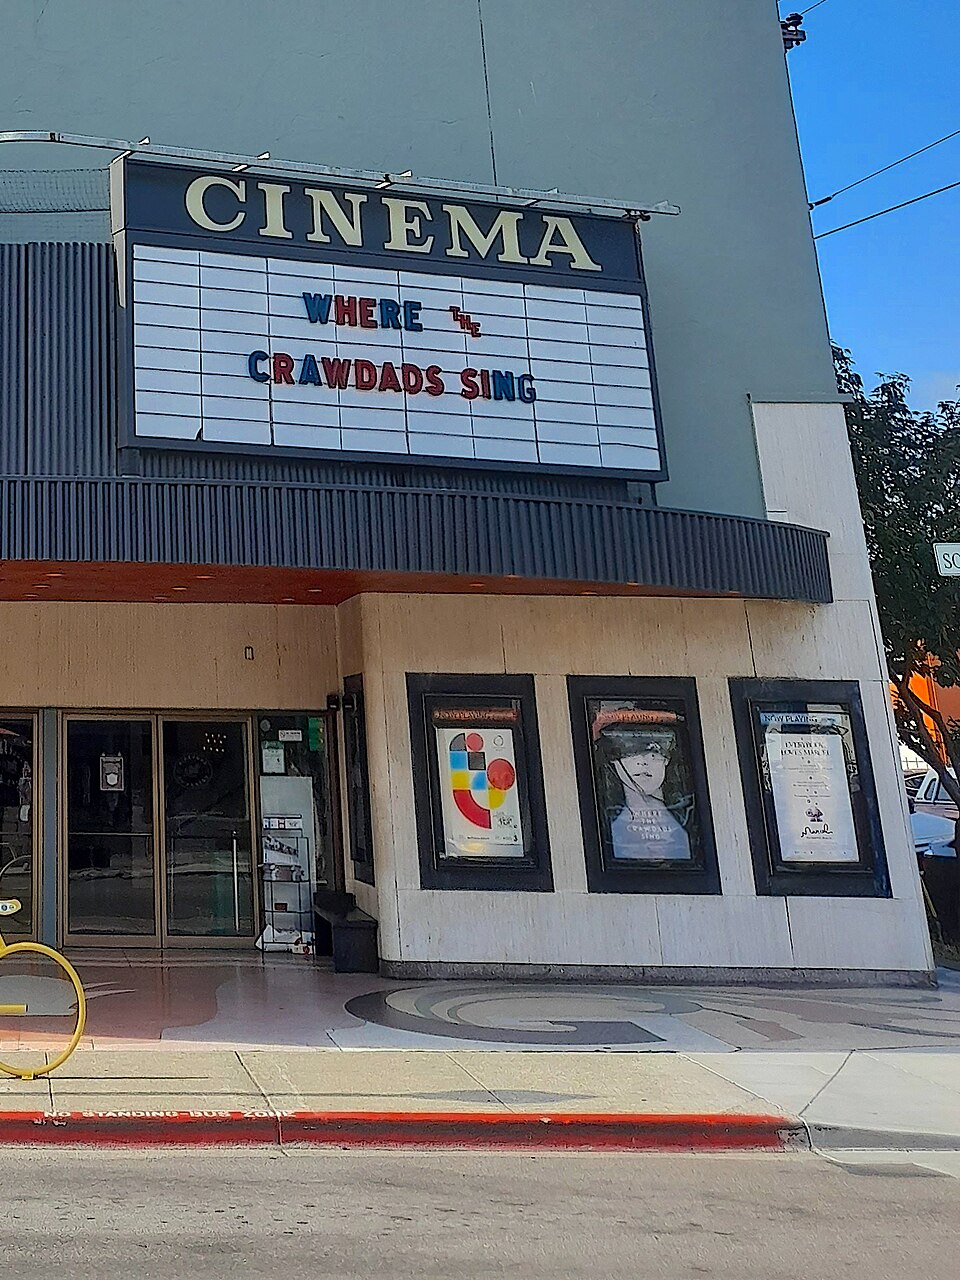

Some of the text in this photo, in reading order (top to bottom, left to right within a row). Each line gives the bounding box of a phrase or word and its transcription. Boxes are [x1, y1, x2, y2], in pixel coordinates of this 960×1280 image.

[185, 175, 602, 271] CINEMA
[303, 292, 481, 337] WHERE THE
[248, 350, 536, 403] CRAWDADS SING
[764, 714, 818, 723] NOW PLAYING
[44, 1110, 71, 1118] NO
